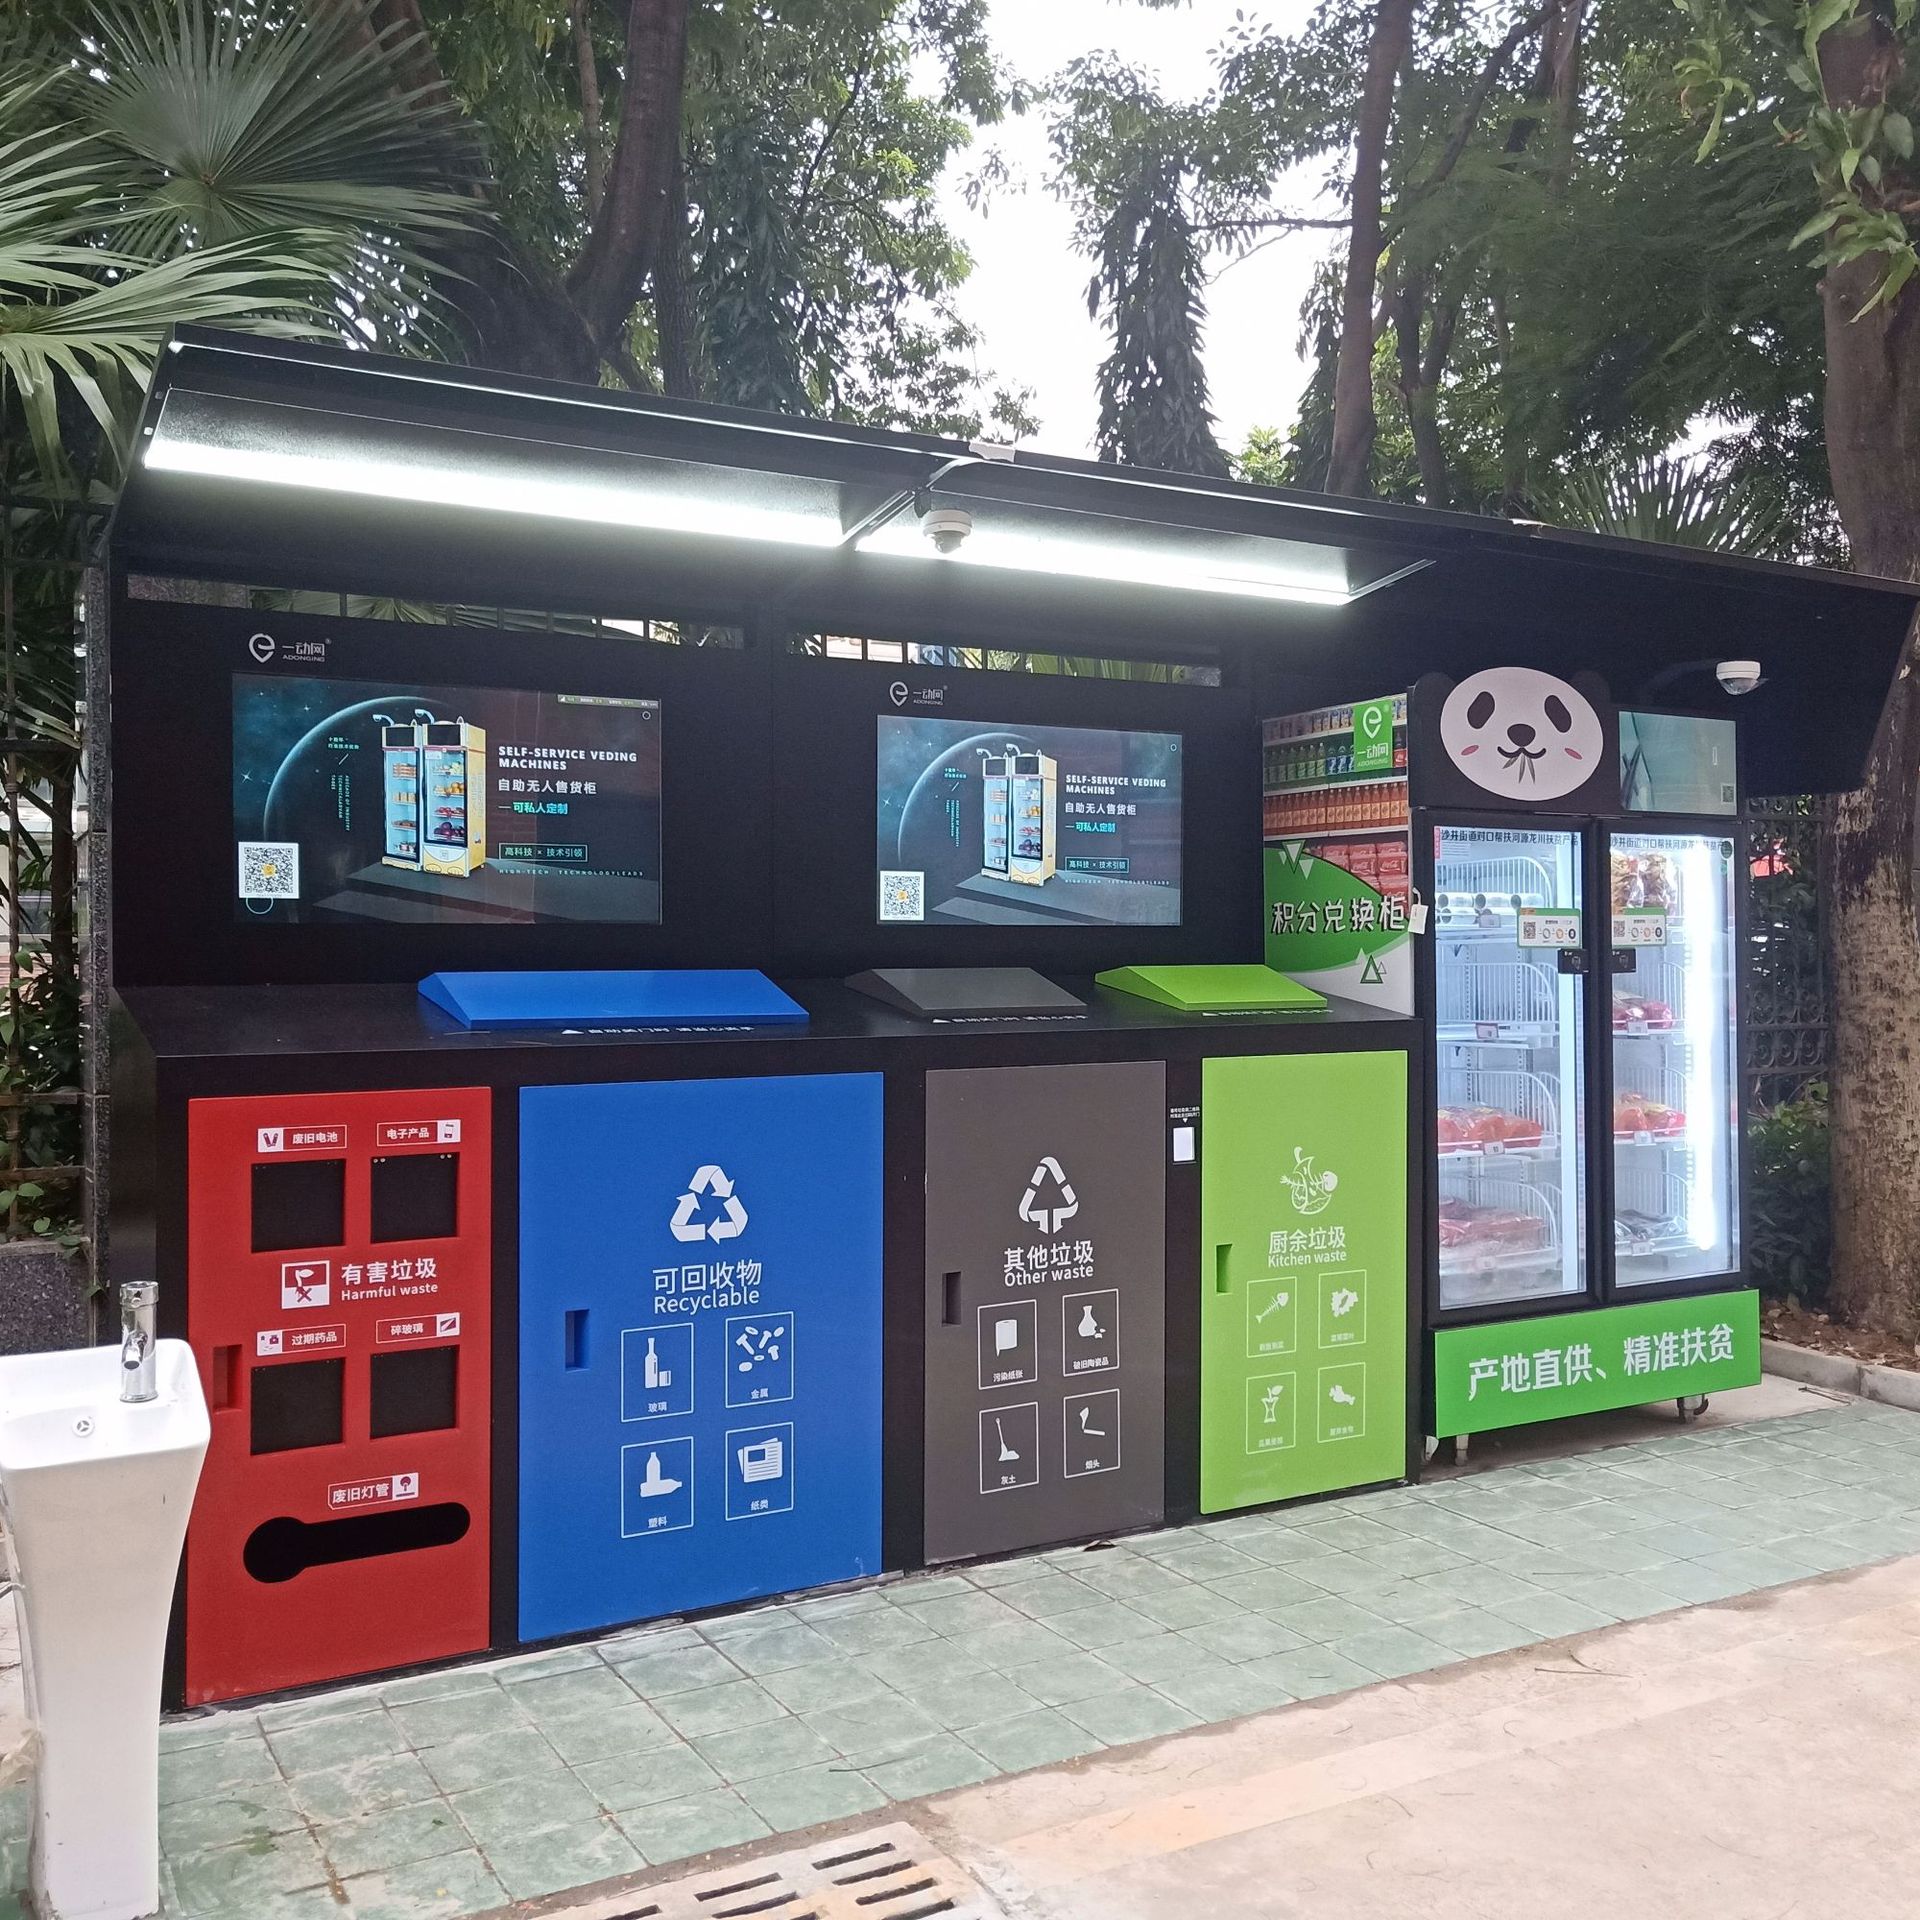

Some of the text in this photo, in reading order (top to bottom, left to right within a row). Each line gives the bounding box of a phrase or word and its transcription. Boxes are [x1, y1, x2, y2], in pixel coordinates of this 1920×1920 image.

[282, 642, 325, 656] 一动网
[499, 746, 637, 762] SELF-SERVICE VEDING
[499, 758, 567, 770] MACHINES
[498, 779, 597, 794] 自助无人售货柜
[1065, 774, 1167, 788] SELF-SERVICE VEDING
[1066, 785, 1115, 795] MACHINES
[1065, 802, 1137, 816] 自助无人售货柜
[1272, 895, 1405, 934] 积分兑换柜
[292, 1131, 338, 1145] 废旧电池
[387, 1127, 430, 1140] 电子产品
[1268, 1225, 1347, 1253] 厨余垃圾
[1003, 1240, 1095, 1273] 其他垃圾
[1268, 1249, 1347, 1269] Kitchen waste
[341, 1257, 437, 1286] 有害垃圾
[652, 1259, 762, 1295] 可回收物
[1004, 1264, 1094, 1287] Other waste
[341, 1282, 438, 1301] Harmful waste
[654, 1286, 760, 1316] Recyclable
[390, 1322, 424, 1336] 碎玻璃
[291, 1332, 338, 1346] 过期药品
[750, 1388, 769, 1400] 金属
[648, 1401, 667, 1413] 玻璃
[332, 1482, 390, 1504] 废旧灯管
[750, 1499, 769, 1511] 纸类
[648, 1516, 667, 1528] 塑料
